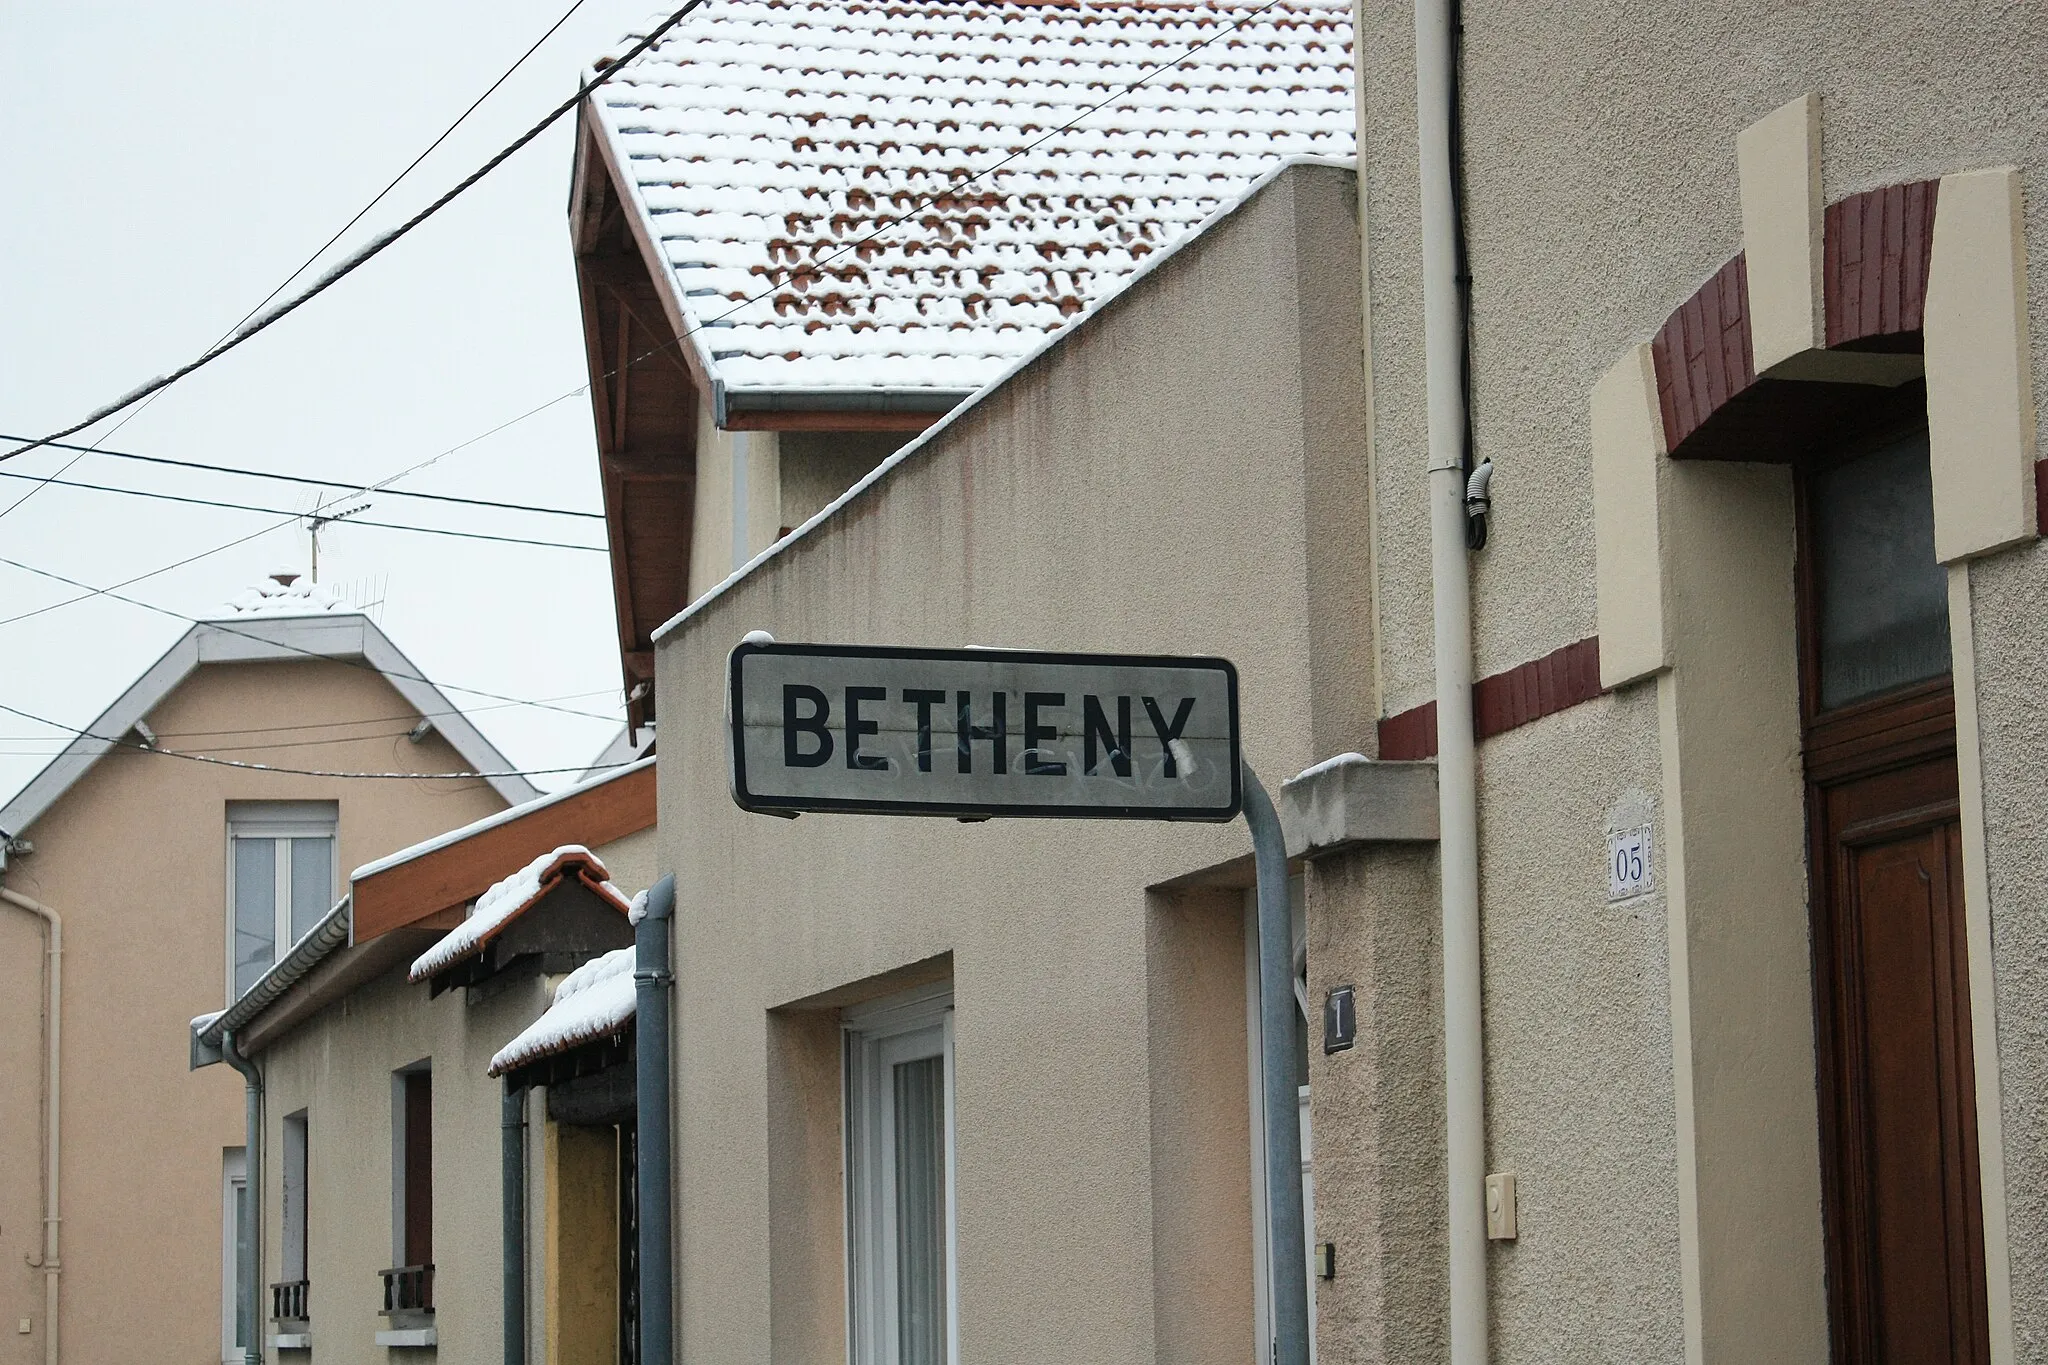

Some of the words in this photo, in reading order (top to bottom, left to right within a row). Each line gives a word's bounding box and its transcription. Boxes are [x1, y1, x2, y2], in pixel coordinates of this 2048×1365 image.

[782, 684, 1196, 779] BETHENY
[1616, 843, 1642, 882] 05
[1333, 999, 1343, 1039] 1
